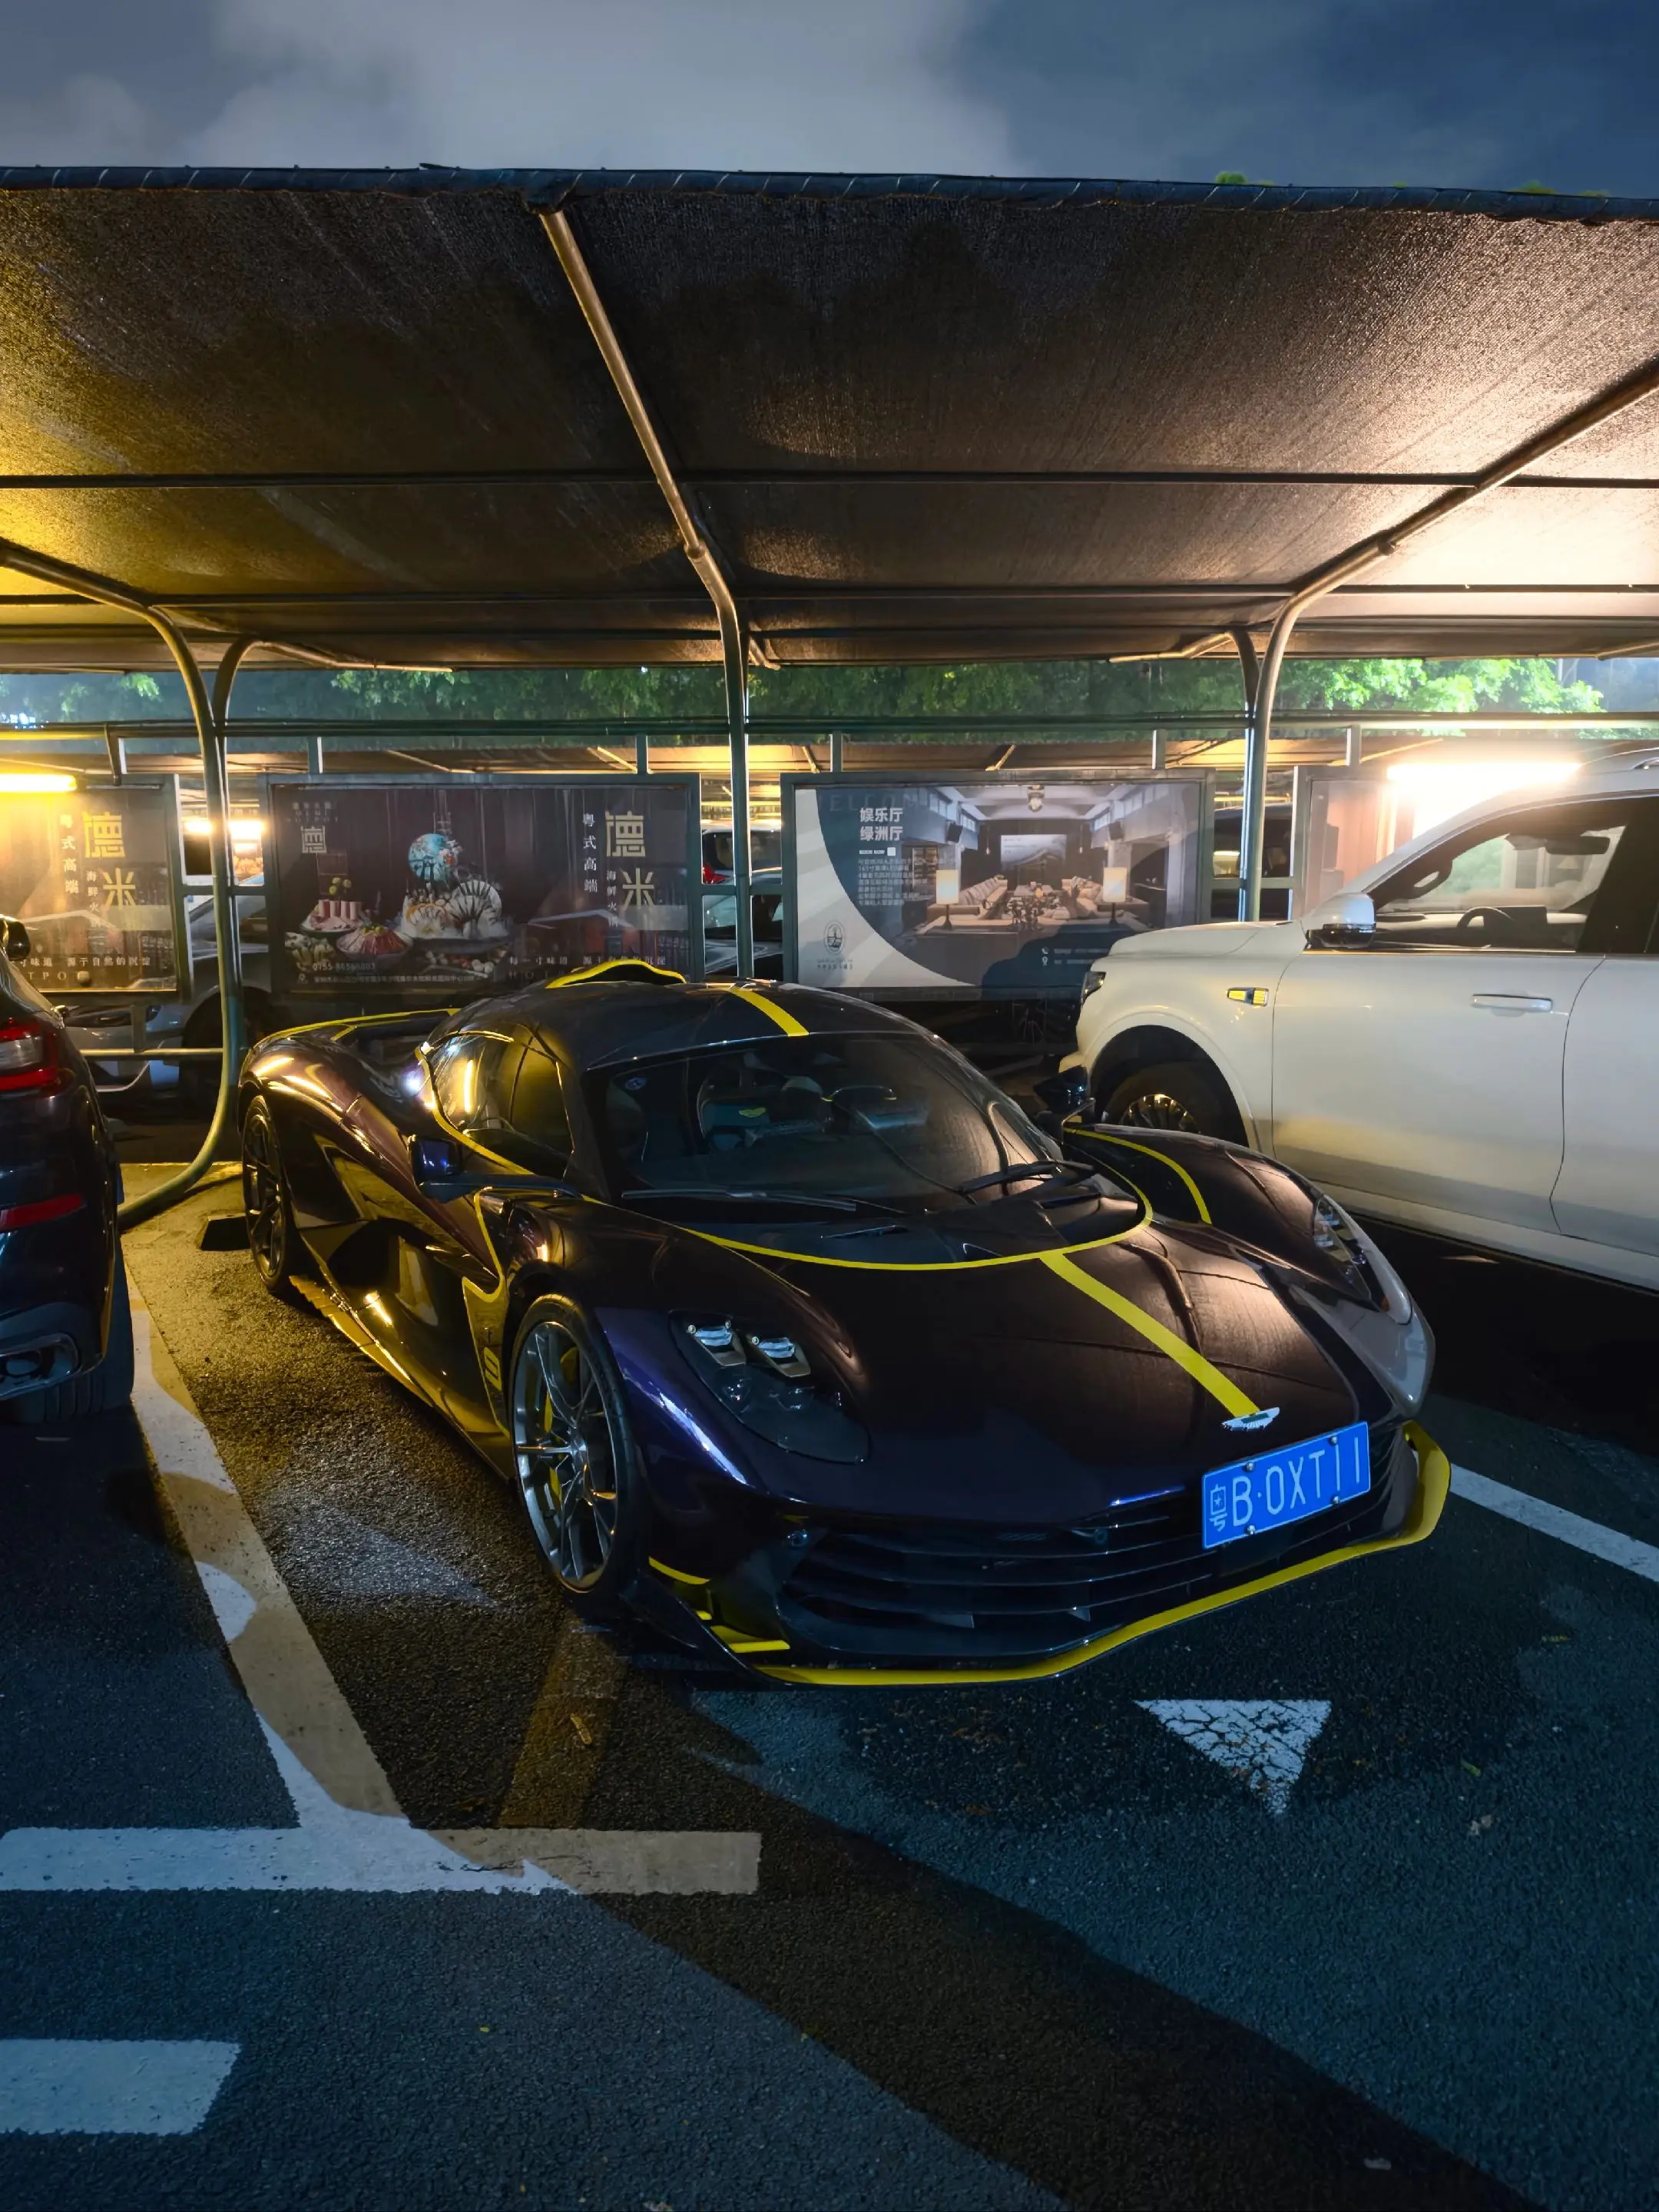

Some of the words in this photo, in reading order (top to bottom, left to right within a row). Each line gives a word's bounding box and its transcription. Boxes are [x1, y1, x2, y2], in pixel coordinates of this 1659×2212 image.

[859, 808, 903, 823] 娱乐厅
[859, 826, 903, 841] 绿洲厅
[582, 813, 598, 893] 粤式高端
